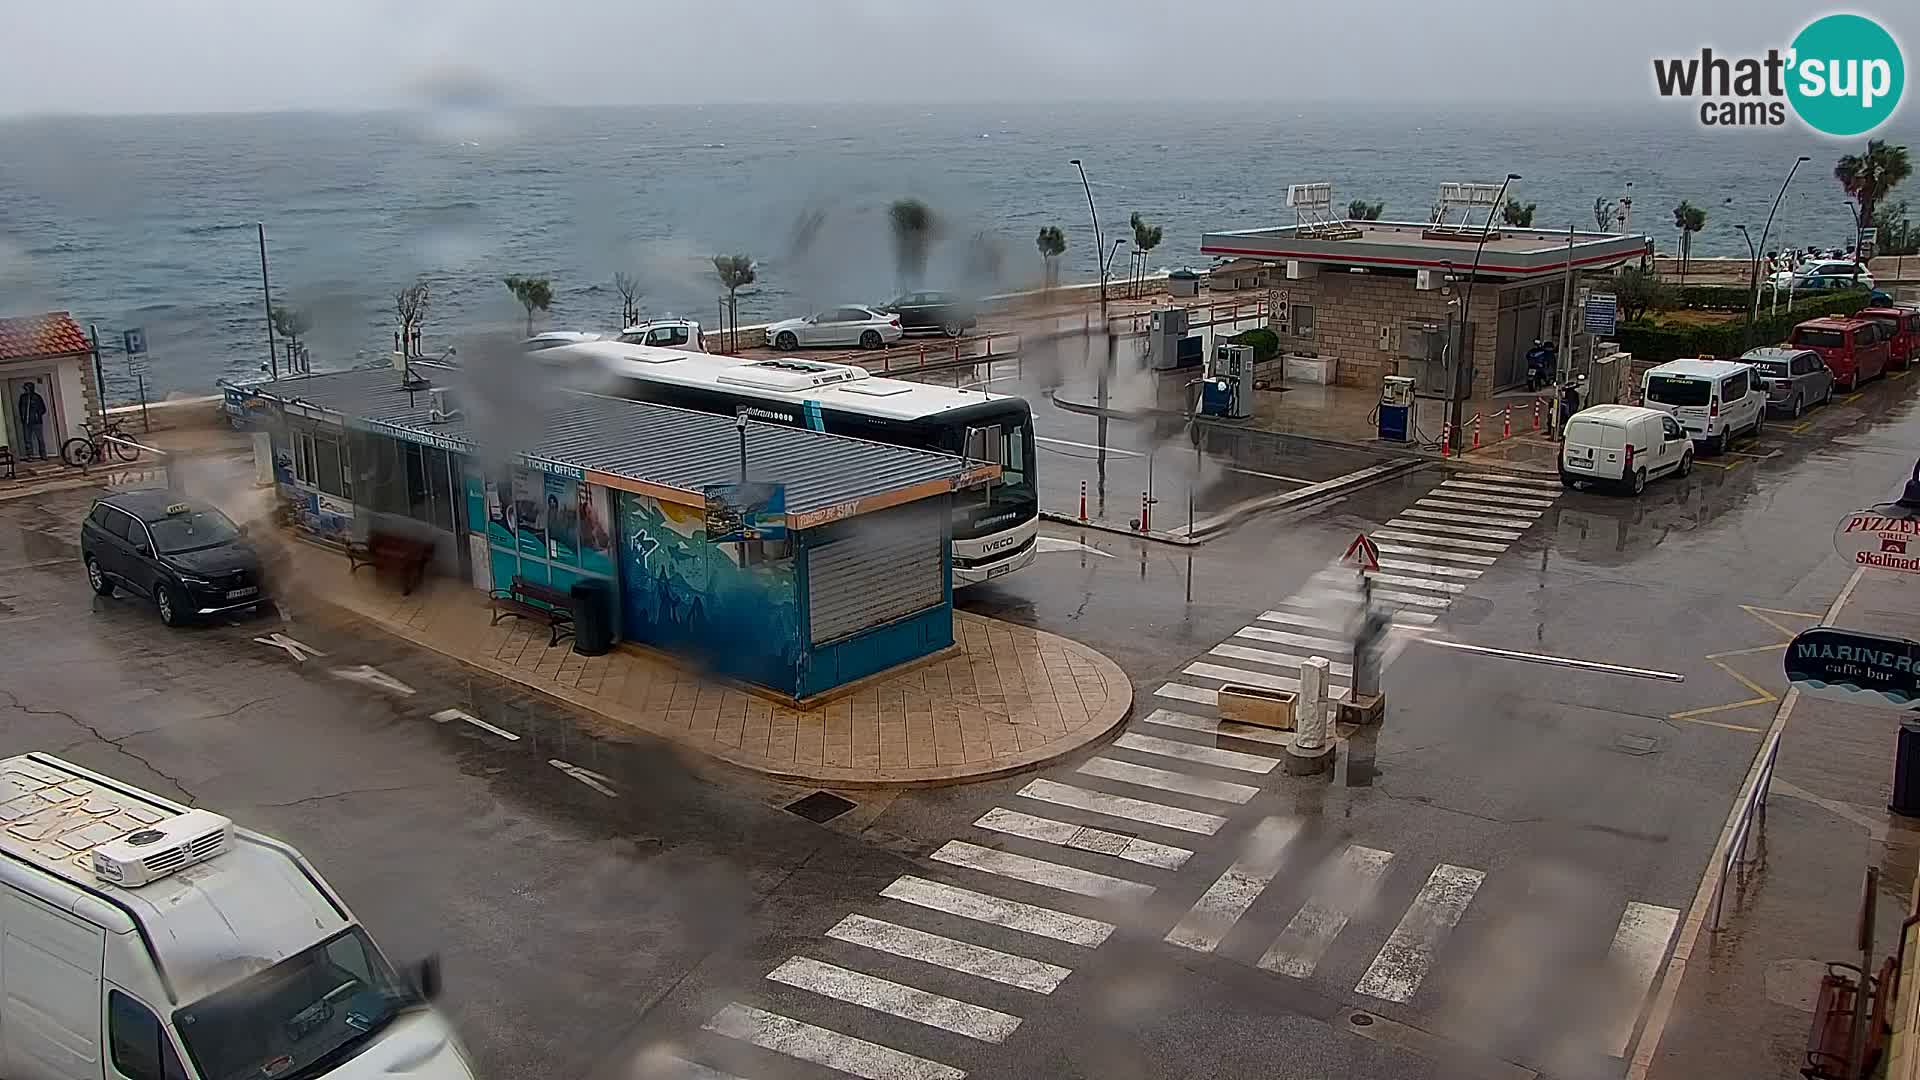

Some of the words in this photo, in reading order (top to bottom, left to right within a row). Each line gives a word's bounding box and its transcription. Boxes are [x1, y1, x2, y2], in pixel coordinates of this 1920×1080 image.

[130, 333, 141, 351] P
[528, 459, 553, 472] TICKET
[554, 464, 581, 478] OFFICE
[983, 537, 1014, 553] IVECO
[1878, 531, 1912, 542] GRILL
[1825, 663, 1861, 675] caffe
[1867, 666, 1893, 680] bar
